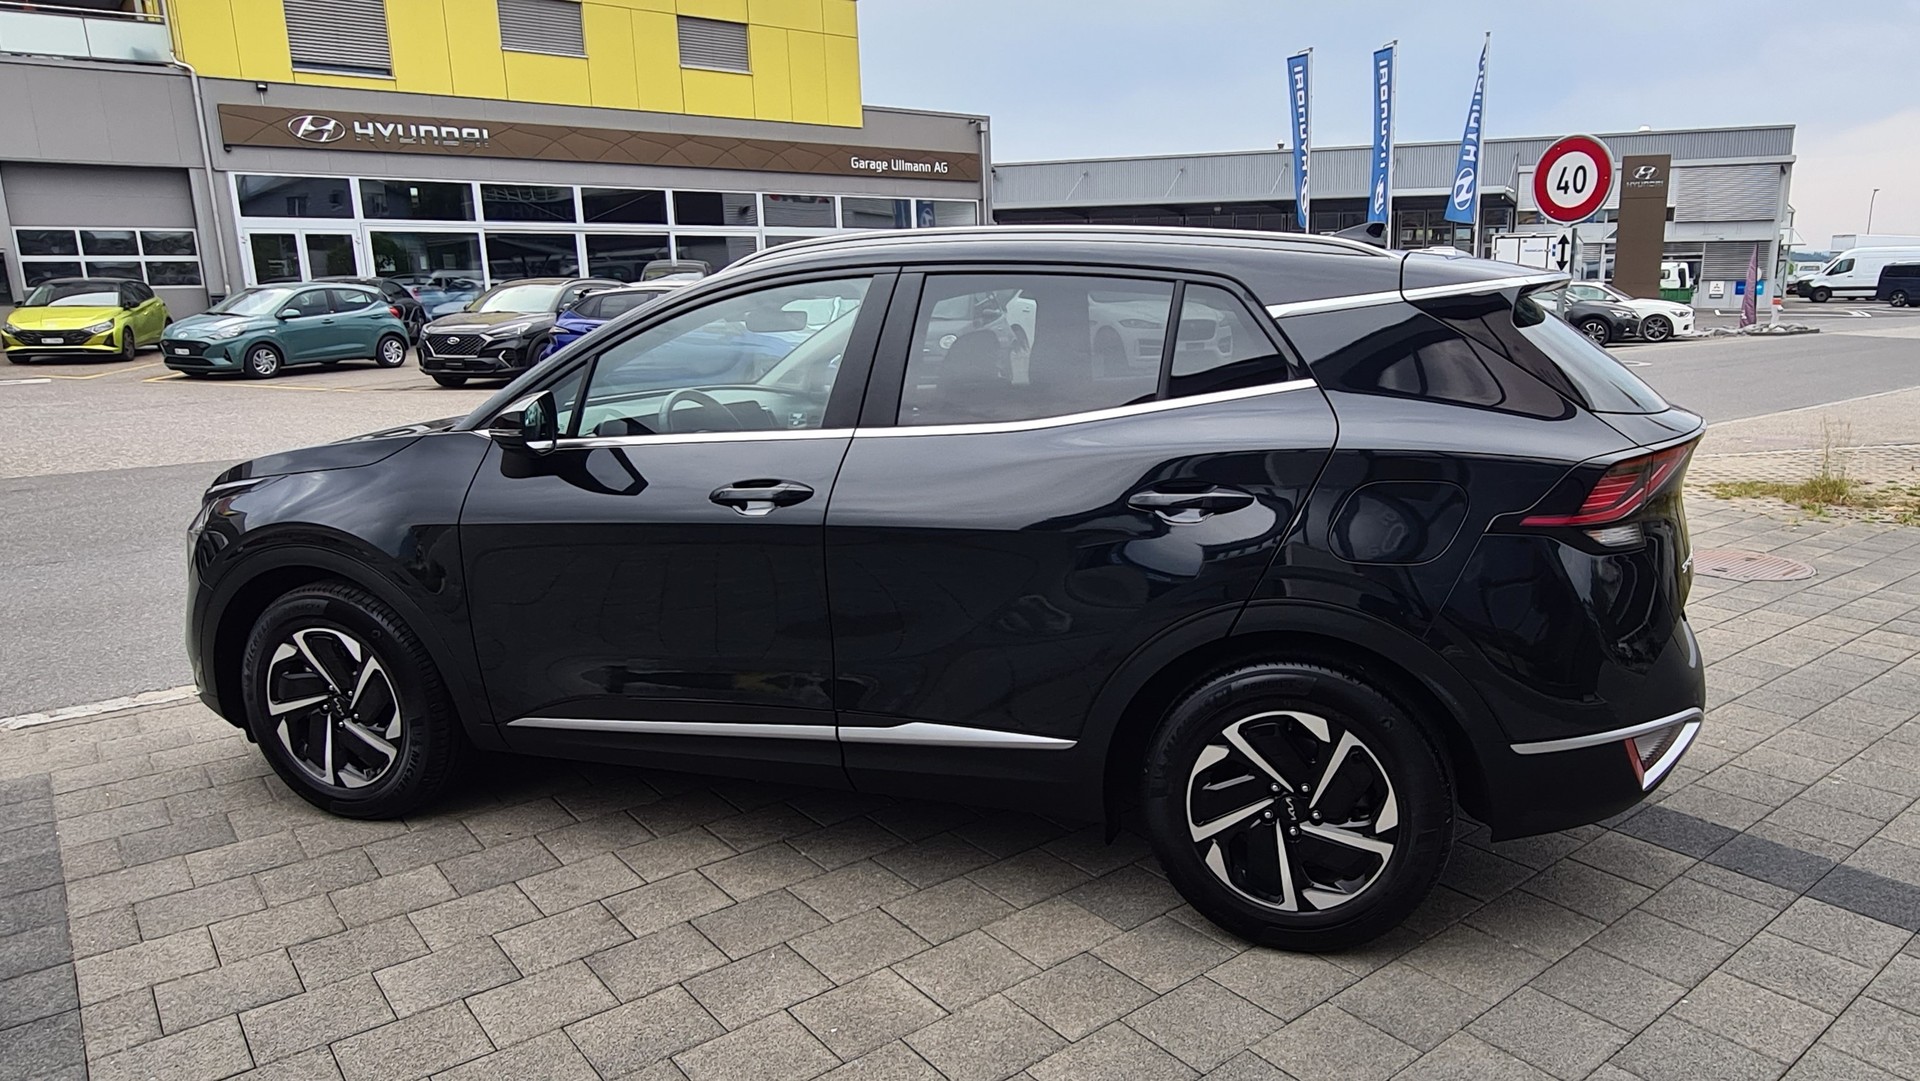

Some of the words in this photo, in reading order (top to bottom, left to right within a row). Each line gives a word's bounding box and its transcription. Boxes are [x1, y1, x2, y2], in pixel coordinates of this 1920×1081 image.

[354, 120, 489, 147] HYUNDAI
[850, 156, 889, 173] Garage
[891, 158, 931, 173] Ullmann
[933, 161, 948, 173] AG
[1556, 164, 1588, 195] 40
